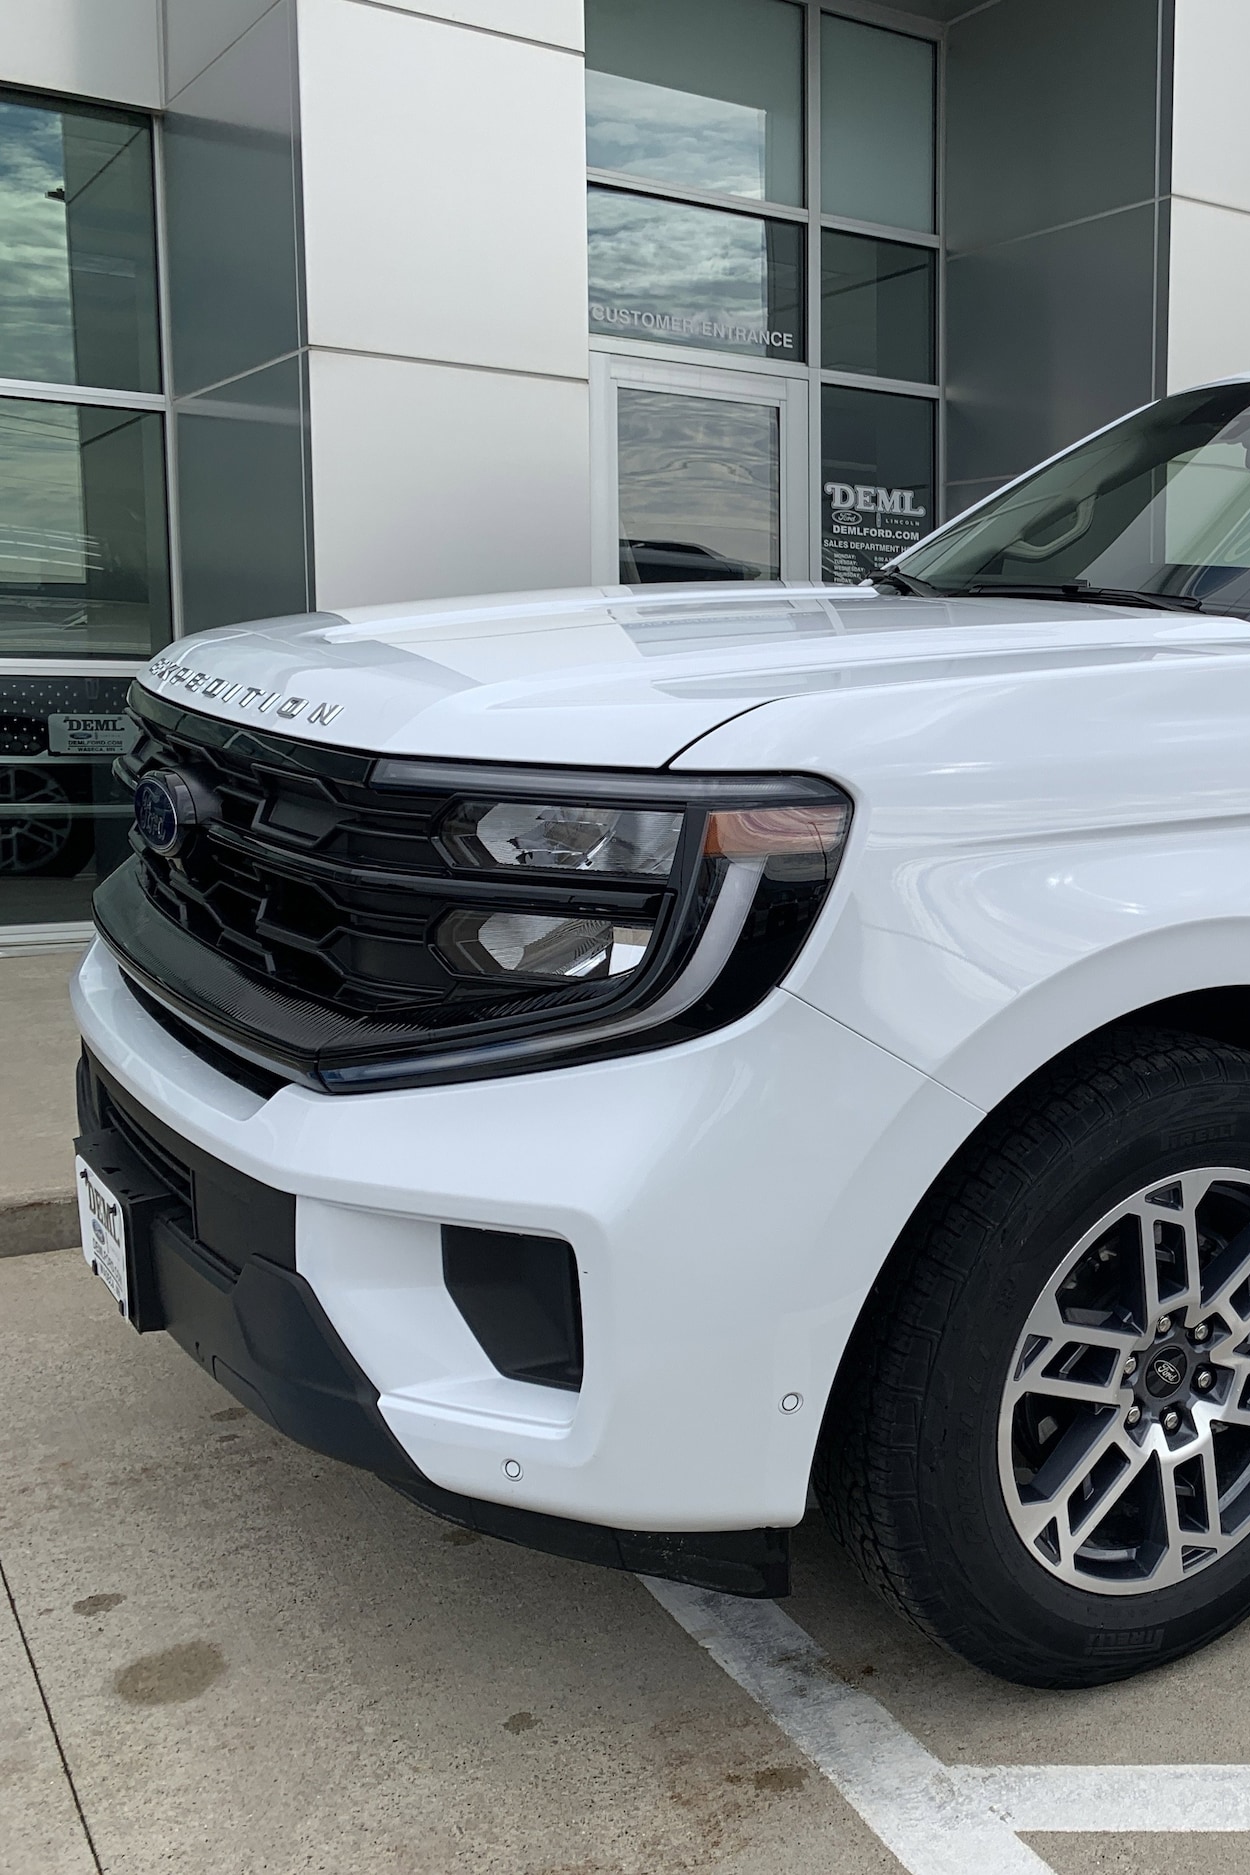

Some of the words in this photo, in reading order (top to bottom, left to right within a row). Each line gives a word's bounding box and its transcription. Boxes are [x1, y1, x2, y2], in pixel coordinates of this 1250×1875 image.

[591, 306, 694, 333] CUSTOMER
[702, 322, 794, 348] ENTRANCE
[824, 482, 926, 517] DEML
[885, 518, 920, 527] LINCOLN
[832, 525, 920, 540] DEMLFORD.COM
[823, 539, 849, 549] SALES
[850, 542, 899, 553] DEPARTMENT
[149, 658, 345, 726] EXPEDITION
[63, 719, 125, 732] DEML
